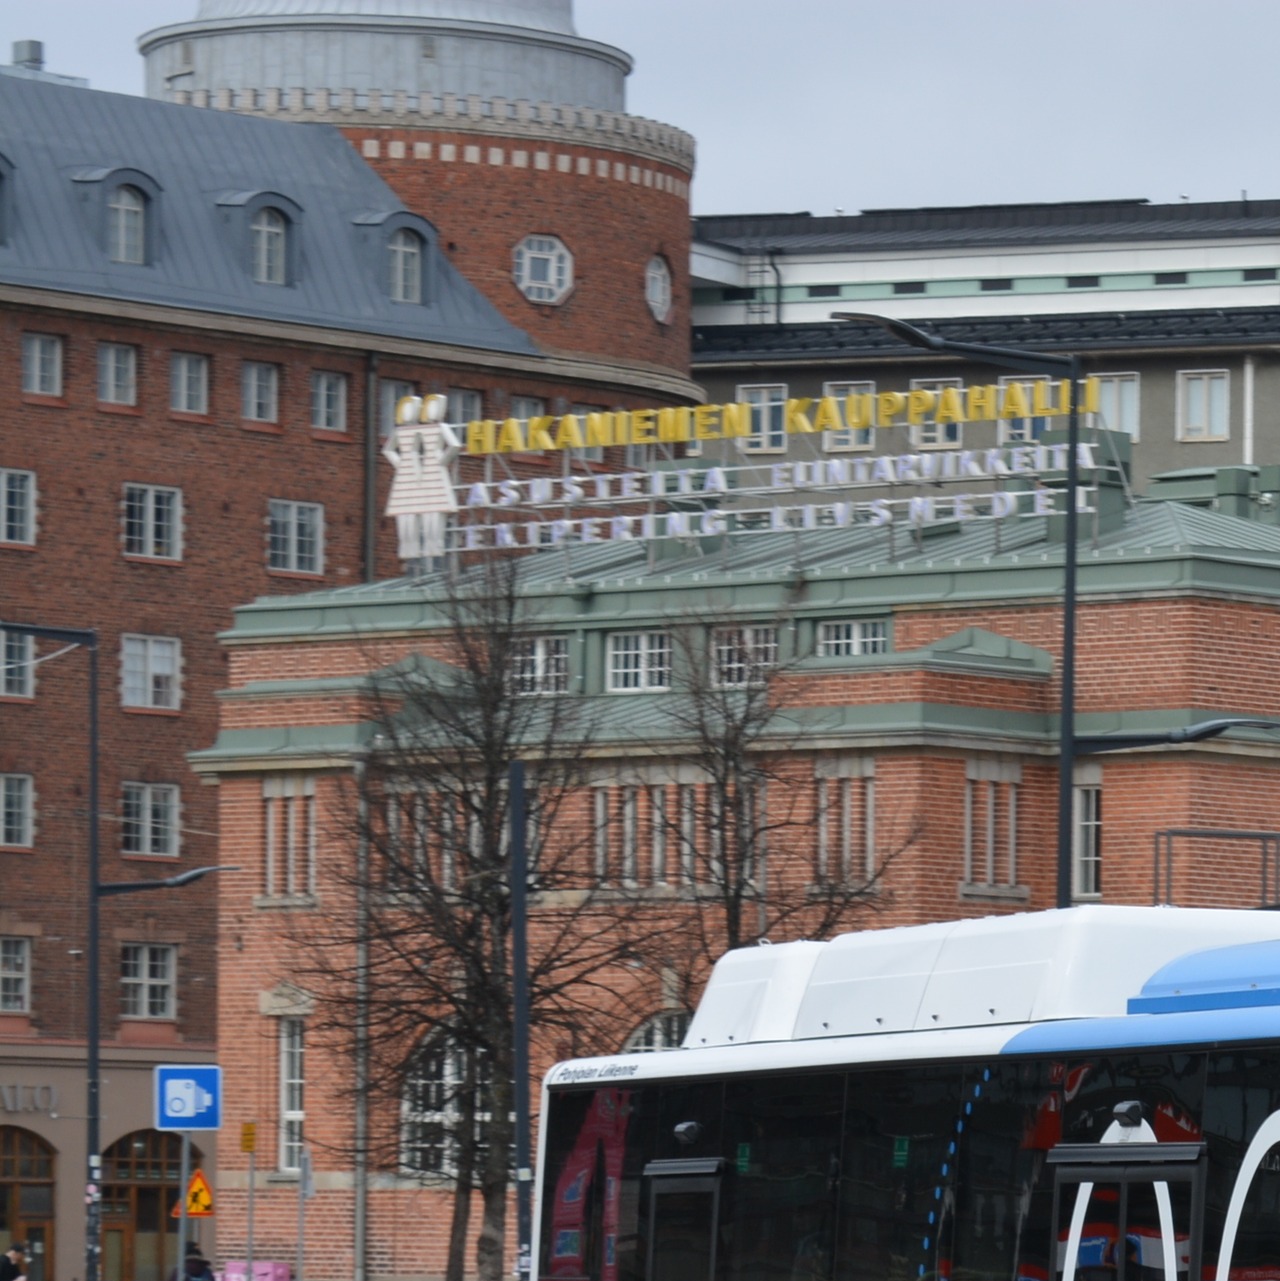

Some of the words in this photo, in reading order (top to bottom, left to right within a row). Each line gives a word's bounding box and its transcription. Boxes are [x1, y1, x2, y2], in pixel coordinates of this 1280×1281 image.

[467, 402, 752, 455] HAKANIEMEN
[786, 375, 1100, 434] KAUPPAHALLI
[468, 466, 728, 507] ASUSTEITA
[771, 443, 1096, 487] ELINTARVIKKEITA
[465, 509, 728, 549] EKIPERING
[770, 485, 1097, 531] LIVSMEDEL
[557, 1067, 598, 1082] Pohjolan
[598, 1063, 639, 1078] Liikenne
